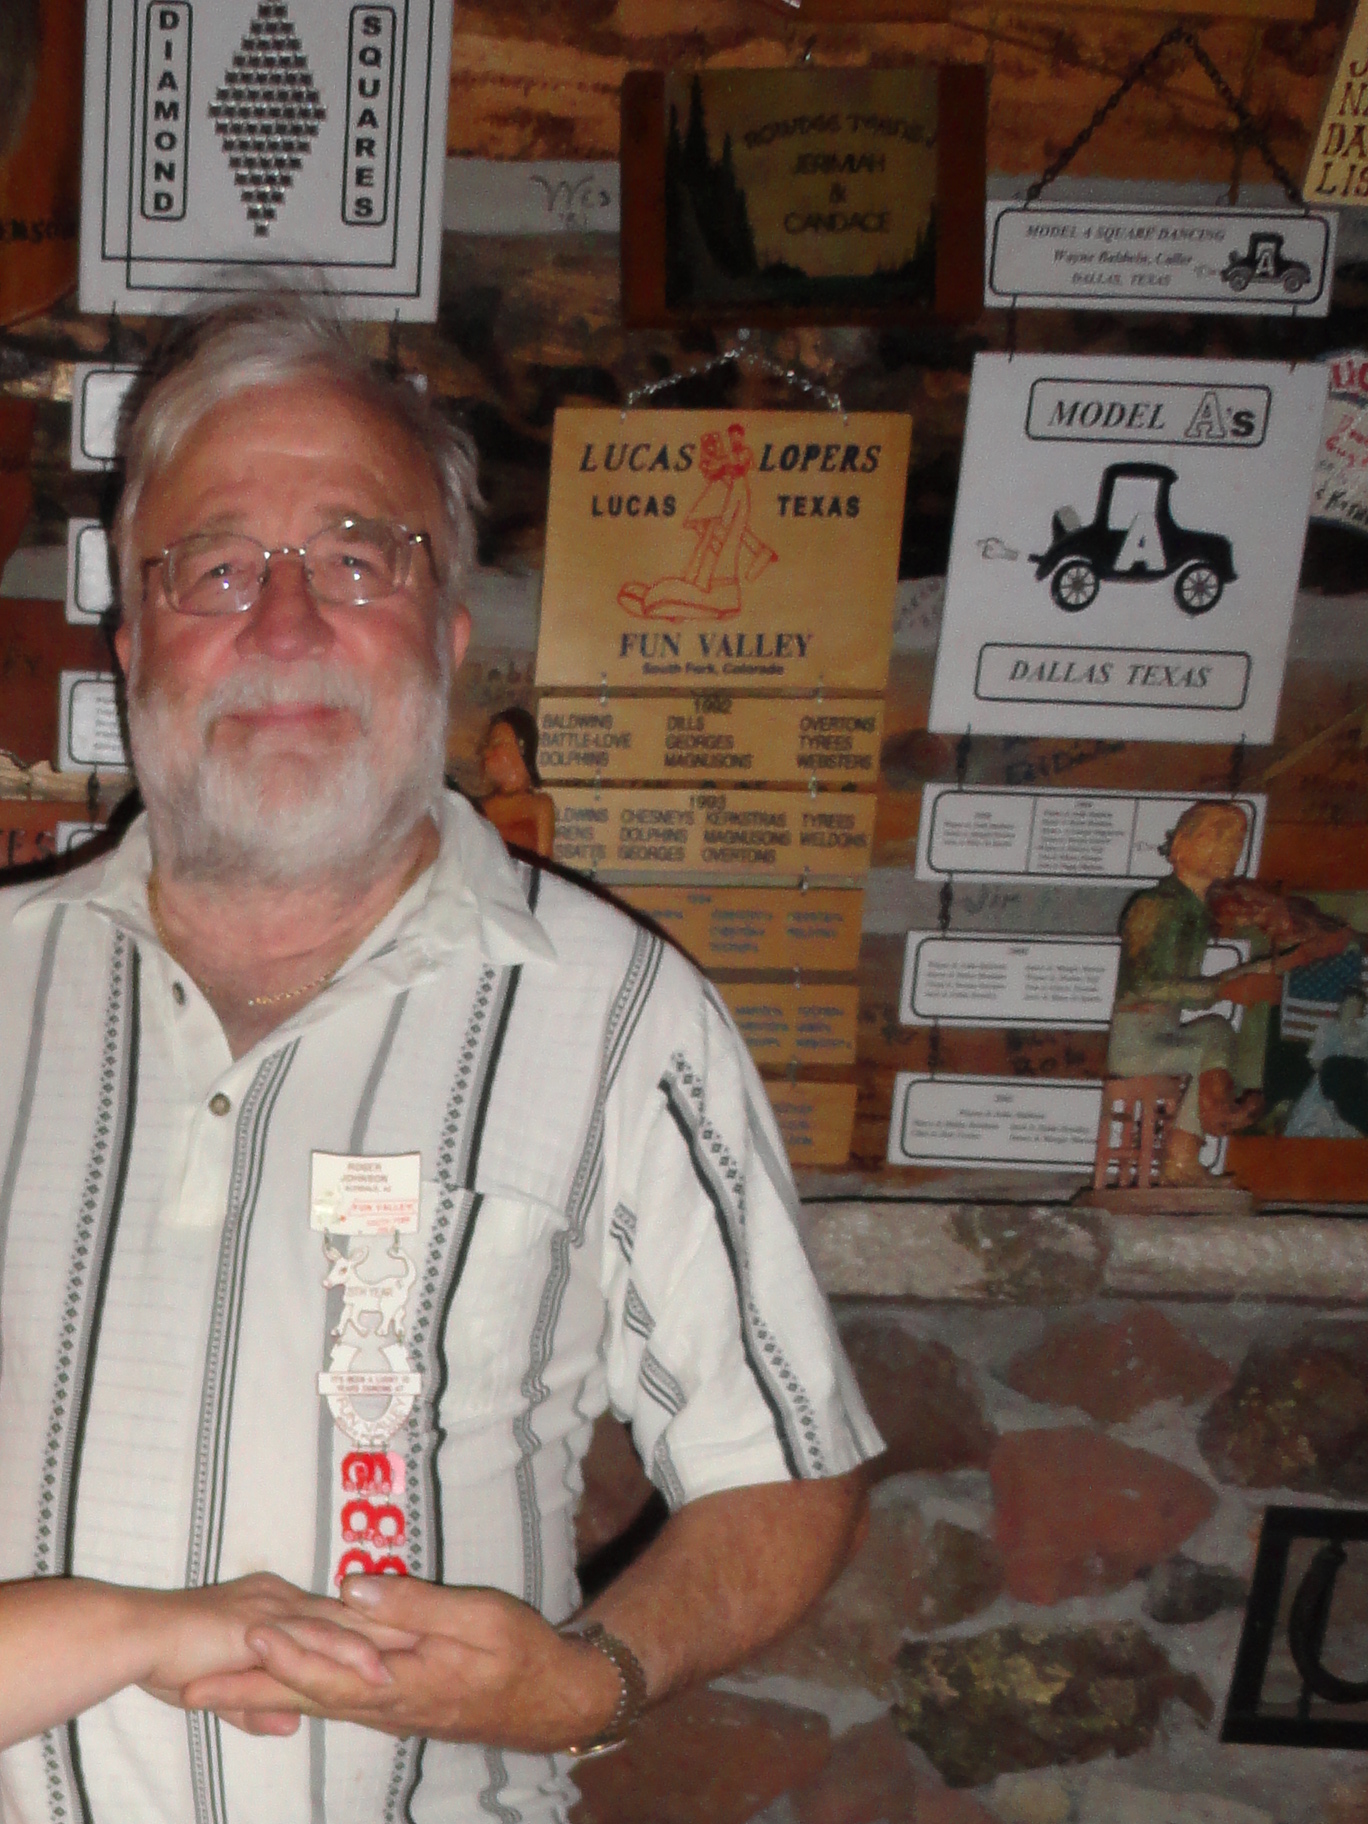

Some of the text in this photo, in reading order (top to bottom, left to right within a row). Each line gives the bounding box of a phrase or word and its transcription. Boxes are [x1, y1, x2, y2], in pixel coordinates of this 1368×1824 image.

[153, 10, 180, 212] DIAMOND
[354, 17, 382, 218] SQUARES
[1026, 224, 1077, 240] MODEL
[1095, 226, 1157, 244] SQUARE
[1157, 227, 1227, 243] DANCING
[1129, 272, 1173, 287] TEXAS
[1047, 399, 1166, 430] MODEL
[578, 442, 882, 475] LUCAS LOPERS
[590, 493, 862, 519] LUCAS TEXAS
[618, 632, 814, 660] FUN VALLEY
[1008, 659, 1213, 690] DALLAS TEXAS
[542, 713, 877, 733] BALDWINS DILLS OVERTONS
[539, 731, 633, 749] BATTLE-LOVE
[665, 734, 735, 750] GEORGES
[539, 750, 874, 770] DOLPHINS MAGNUSONS WEBSTERS
[620, 826, 689, 844] DOLPHINS
[376, 1203, 414, 1212] VALLEY
